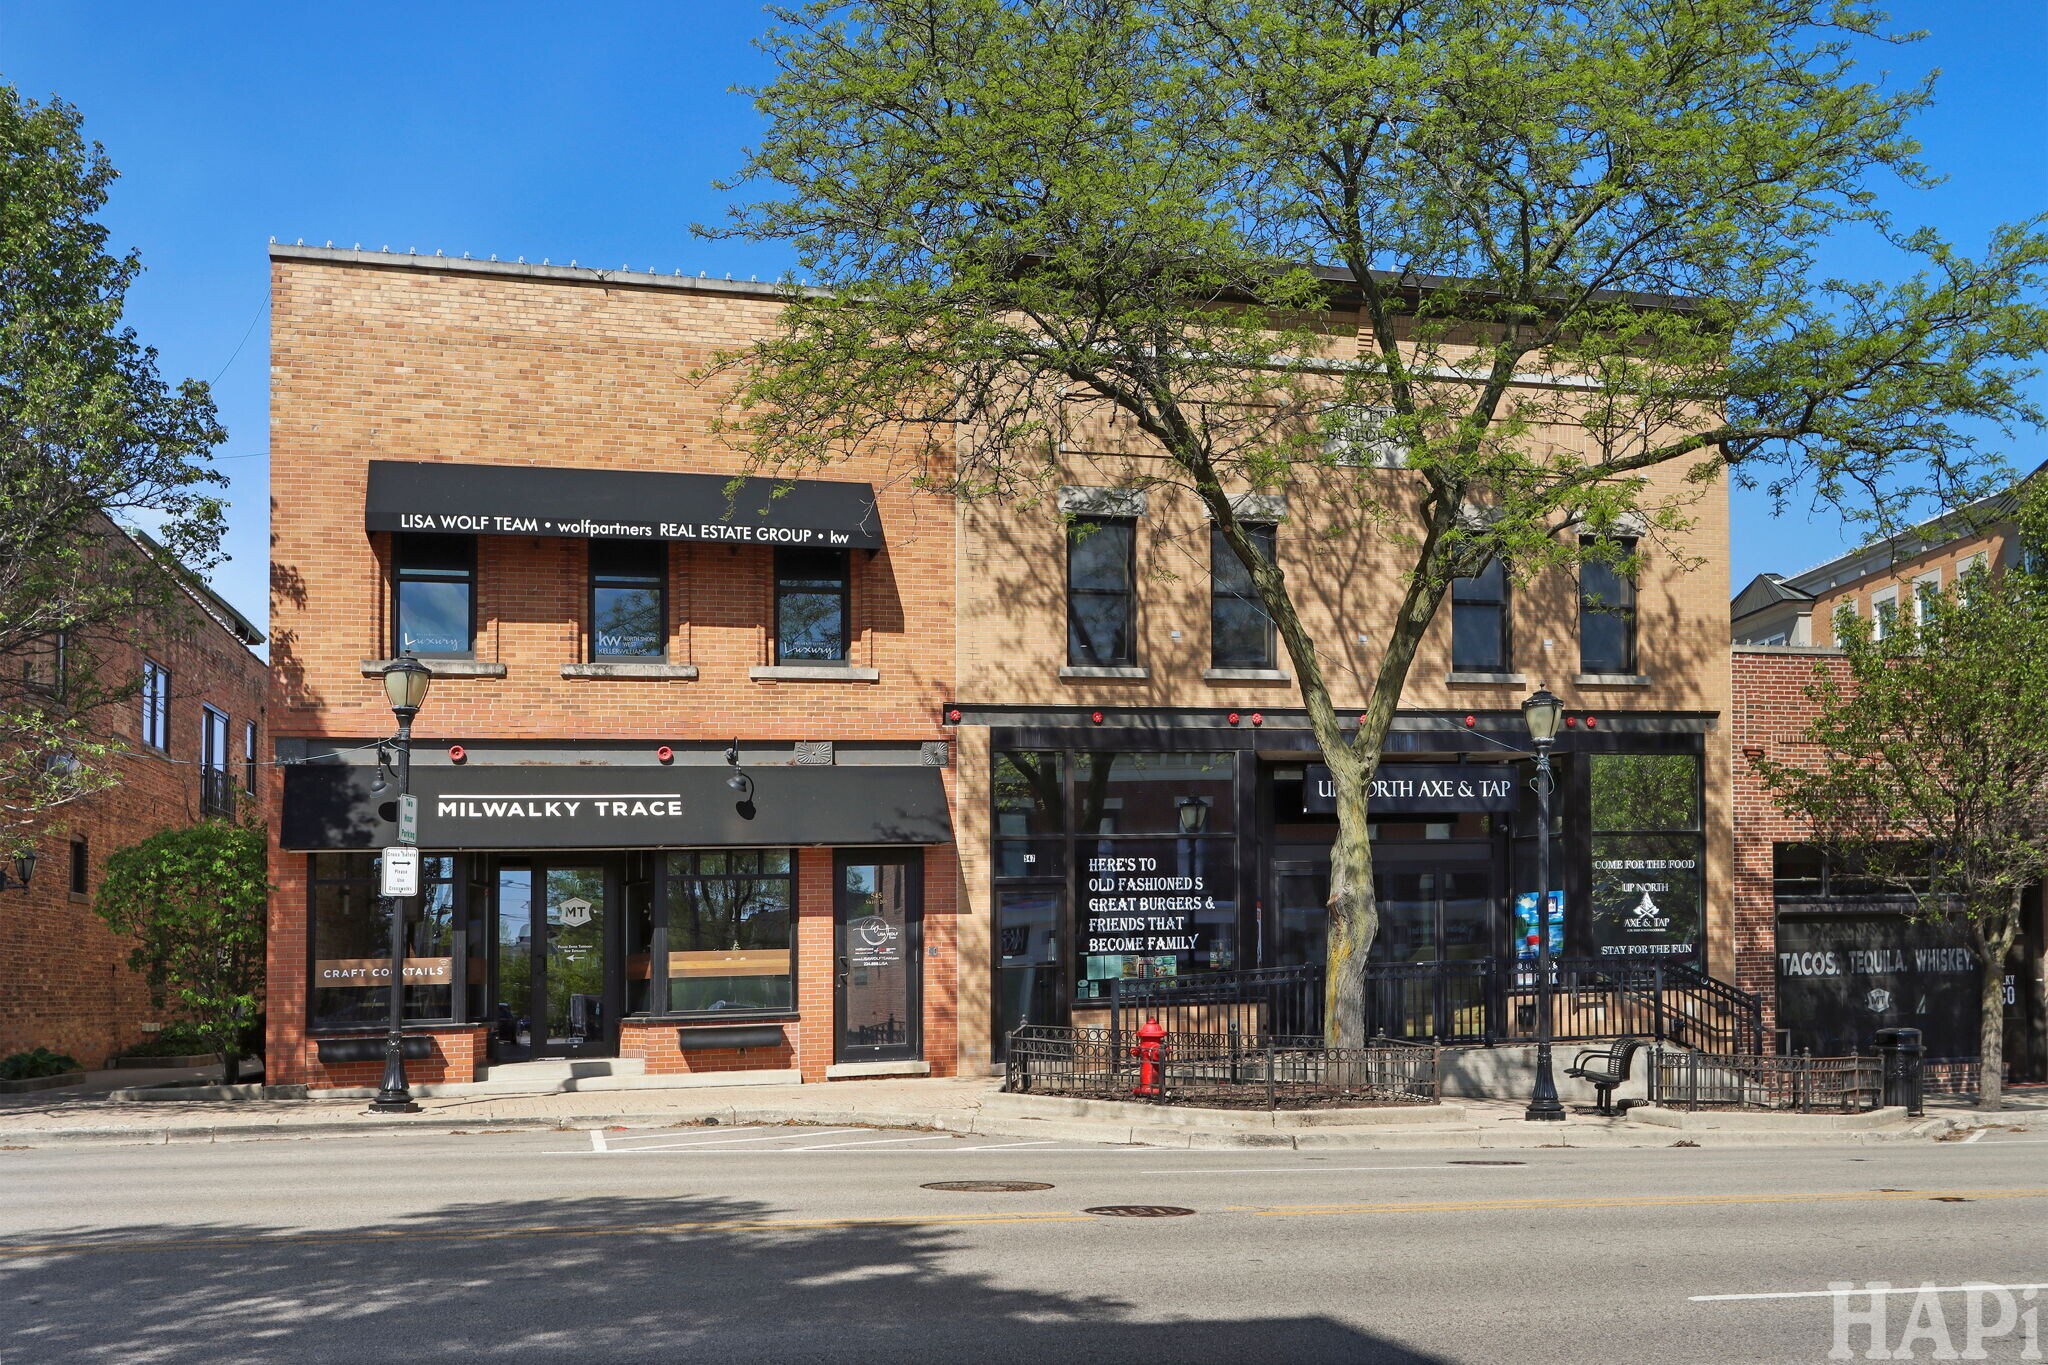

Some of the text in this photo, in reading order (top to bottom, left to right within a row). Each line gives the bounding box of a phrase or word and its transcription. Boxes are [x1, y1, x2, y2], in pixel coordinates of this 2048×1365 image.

[401, 514, 850, 544] LISA WOLF TEAM wolfpartners REAL ESTATE GROUP kw
[404, 632, 460, 651] Luxury
[598, 630, 622, 646] kw
[784, 641, 836, 660] Luxury
[1318, 780, 1336, 797] U
[1418, 780, 1454, 798] AXE
[1457, 780, 1475, 798] &
[1479, 780, 1511, 798] TAP
[437, 800, 683, 817] MILWALKY TRACE
[1088, 857, 1156, 872] HERE'S TO
[1594, 859, 1695, 869] COME FOR THE FOOD
[1088, 878, 1115, 892] OLD
[1622, 882, 1669, 892] UP NORTH
[565, 906, 586, 918] MT
[1088, 896, 1215, 912] GREAT BURGERS &
[1088, 916, 1184, 932] FRIENDS THAT
[1624, 917, 1670, 928] AXE & TAP
[1088, 933, 1199, 951] BECOME FAMILY
[1601, 943, 1693, 955] STAY FOR THE FUN
[1779, 948, 1974, 976] TACOS. TEQUILA. WHISKEY.
[323, 967, 444, 978] CRAFT COKTAILS
